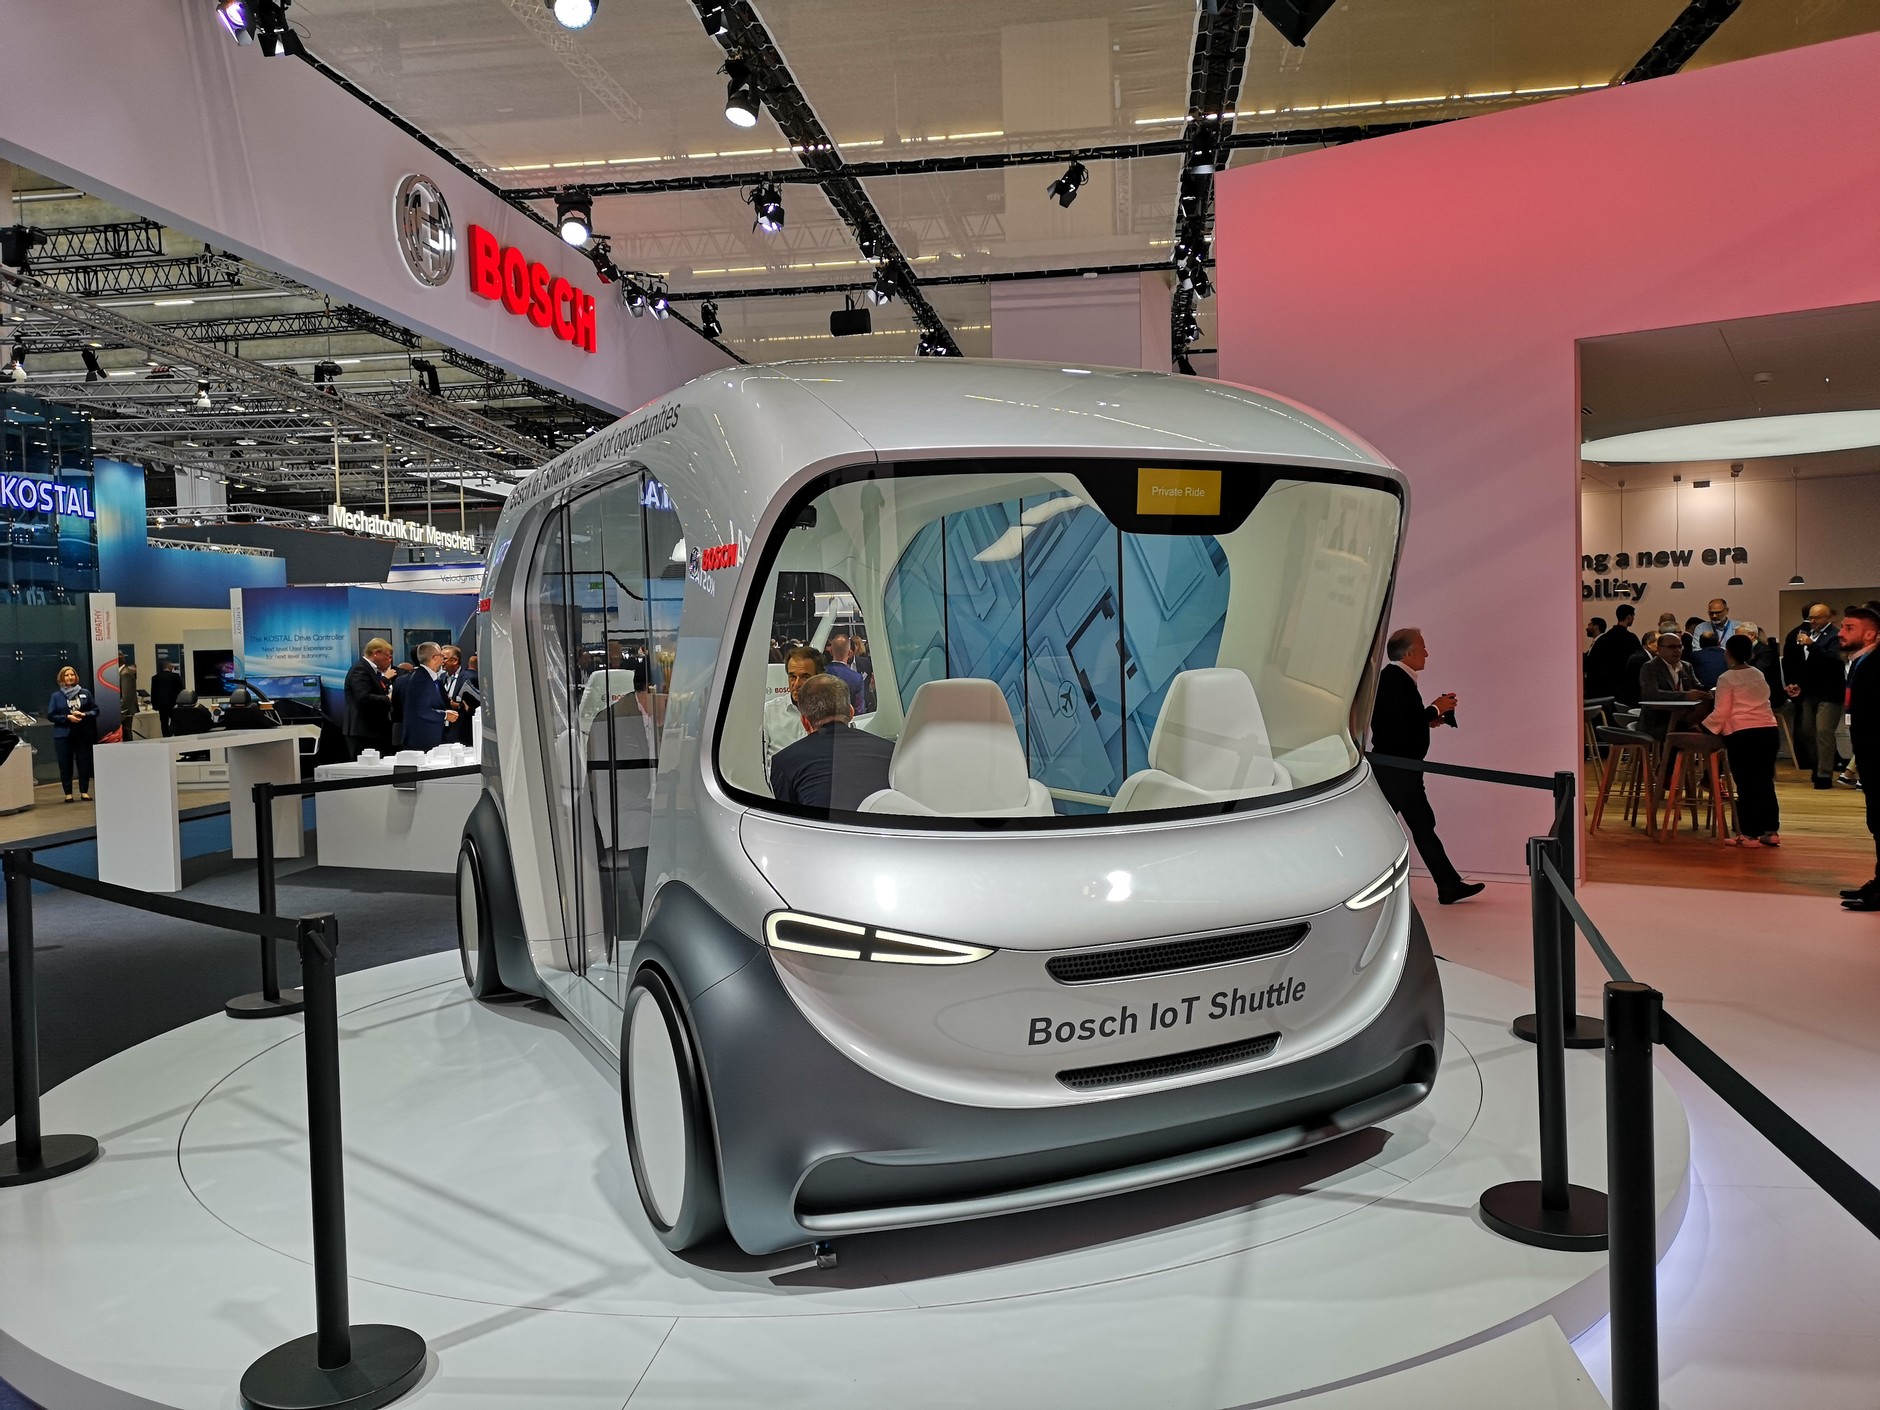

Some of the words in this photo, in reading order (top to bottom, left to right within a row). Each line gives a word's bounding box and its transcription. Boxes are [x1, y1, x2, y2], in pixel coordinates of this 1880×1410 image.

[468, 224, 597, 353] BOSCH
[544, 451, 575, 491] Shuttle
[573, 455, 581, 474] a
[581, 434, 607, 471] world
[603, 427, 618, 459] of
[613, 401, 681, 460] opportunities
[0, 475, 95, 518] KOSTAL
[1151, 486, 1183, 497] Private
[1184, 487, 1205, 497] Ride
[329, 503, 408, 540] Mechatronik
[408, 521, 424, 543] für
[425, 525, 475, 551] Menschen!
[701, 543, 739, 572] BOSCH
[1615, 552, 1630, 569] a
[1637, 548, 1693, 568] new
[1701, 545, 1748, 566] era
[440, 574, 476, 584] Velodyne
[94, 609, 104, 642] EMPATHY
[250, 635, 263, 643] The
[263, 634, 293, 642] KOSTAL
[293, 634, 311, 642] Drive
[312, 633, 345, 641] Controller
[1028, 1005, 1138, 1046] Bosch
[1149, 996, 1201, 1031] IoT
[1208, 976, 1307, 1020] Shuttle
